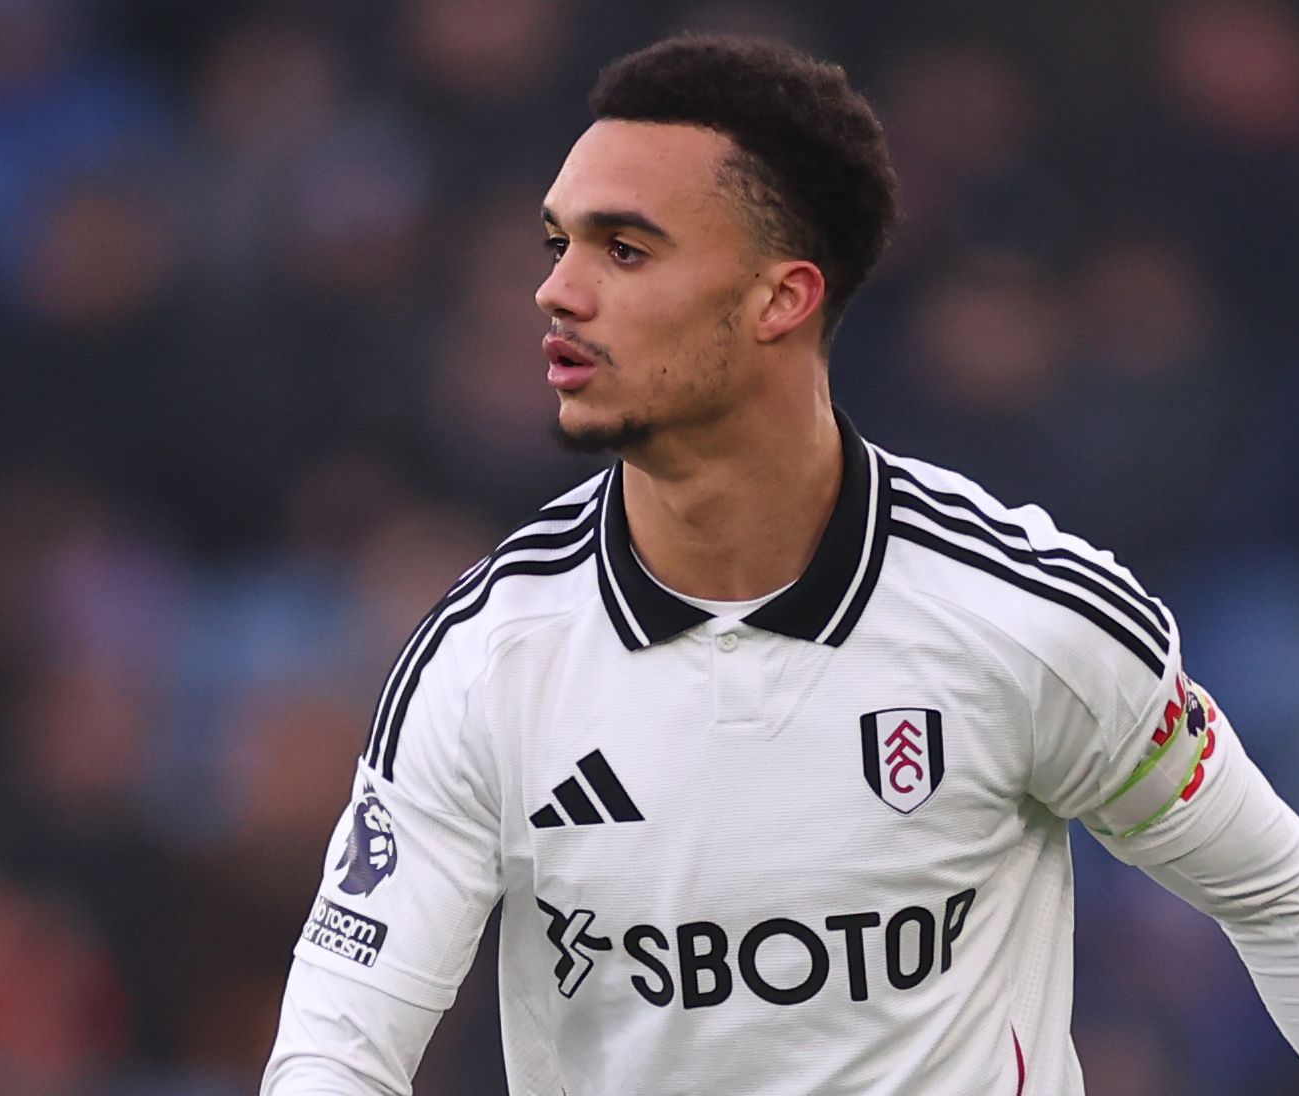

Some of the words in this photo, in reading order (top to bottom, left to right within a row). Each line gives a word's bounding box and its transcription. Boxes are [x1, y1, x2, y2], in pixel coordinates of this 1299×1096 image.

[324, 906, 377, 944] room
[314, 926, 377, 967] racism
[623, 888, 976, 1010] SBOTOP
